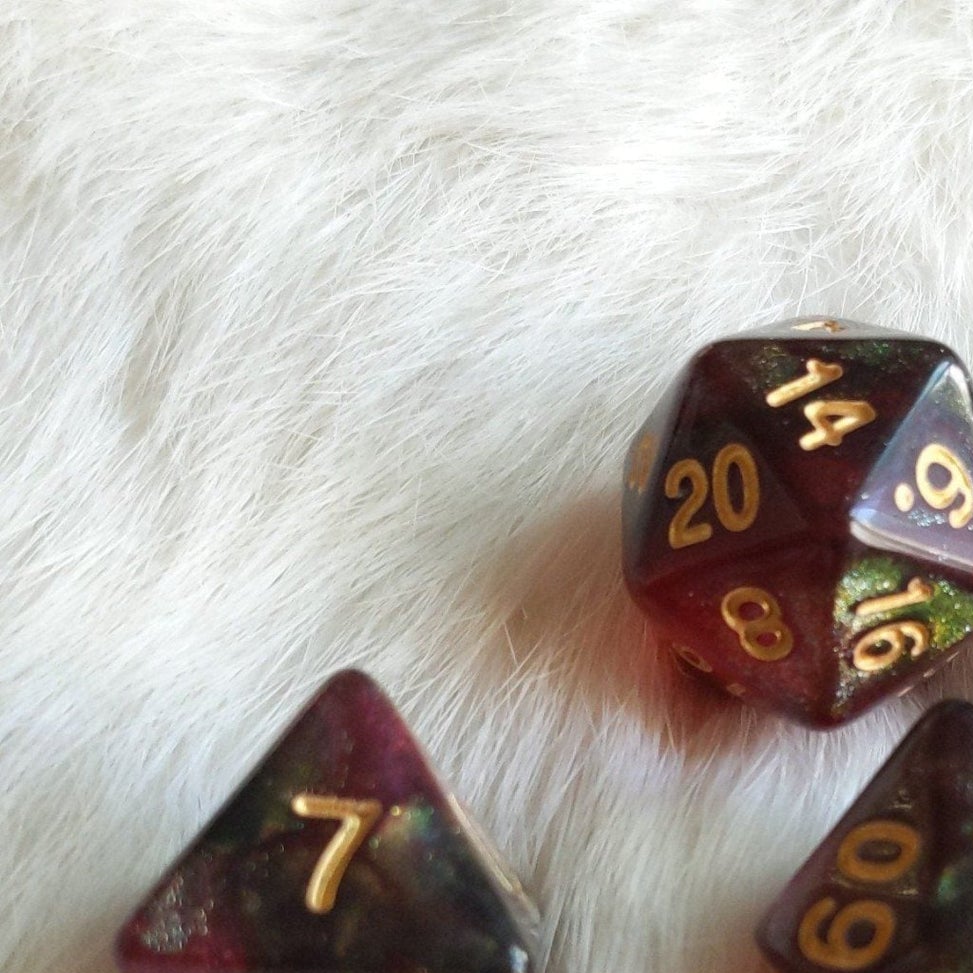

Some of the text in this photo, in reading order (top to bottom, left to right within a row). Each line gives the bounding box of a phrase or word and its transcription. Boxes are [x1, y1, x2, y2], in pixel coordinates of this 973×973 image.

[766, 359, 878, 450] 14
[665, 443, 760, 549] 20
[721, 586, 793, 661] 8
[291, 793, 385, 914] 7
